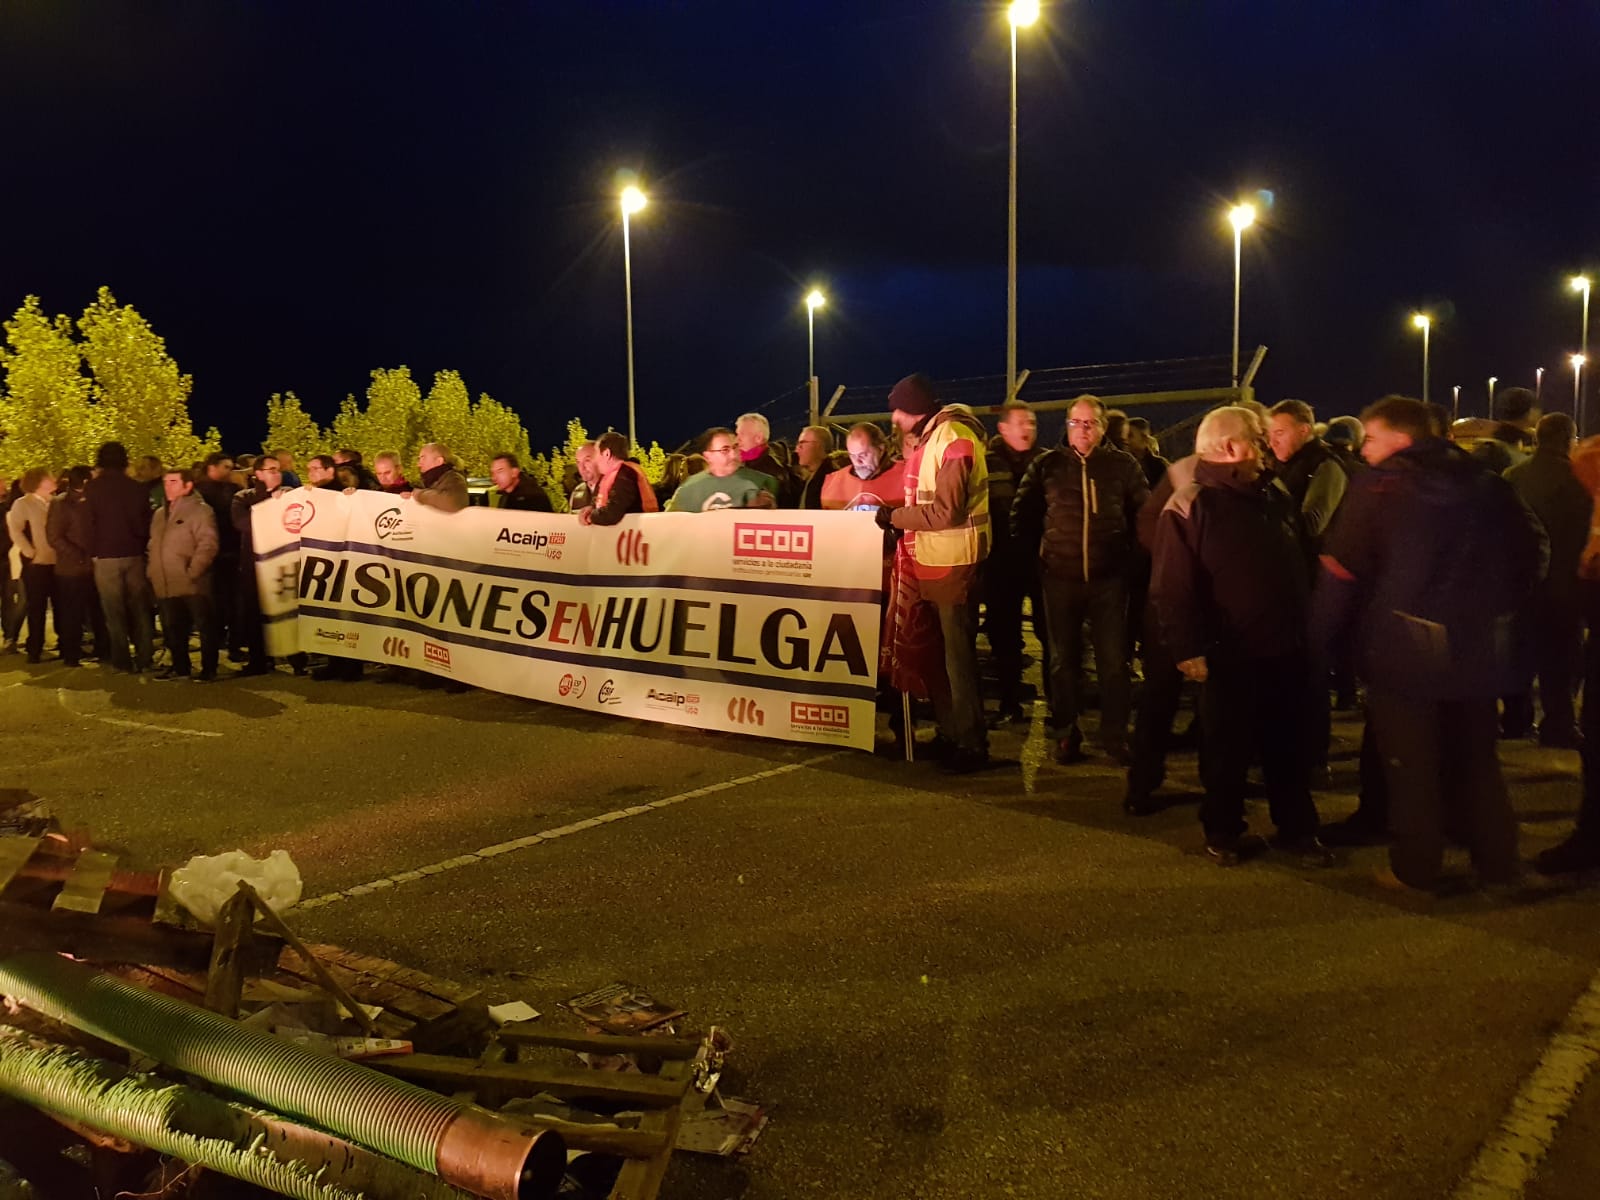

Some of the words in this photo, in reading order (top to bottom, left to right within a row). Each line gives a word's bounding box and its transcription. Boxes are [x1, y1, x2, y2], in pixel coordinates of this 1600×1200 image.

[496, 528, 548, 550] Acaip
[738, 528, 810, 553] CCOO
[274, 555, 550, 640] RISIONES
[597, 597, 869, 678] HUELGA
[425, 644, 450, 661] CCOO
[646, 688, 686, 706] Acaip
[794, 705, 847, 724] CCOO
